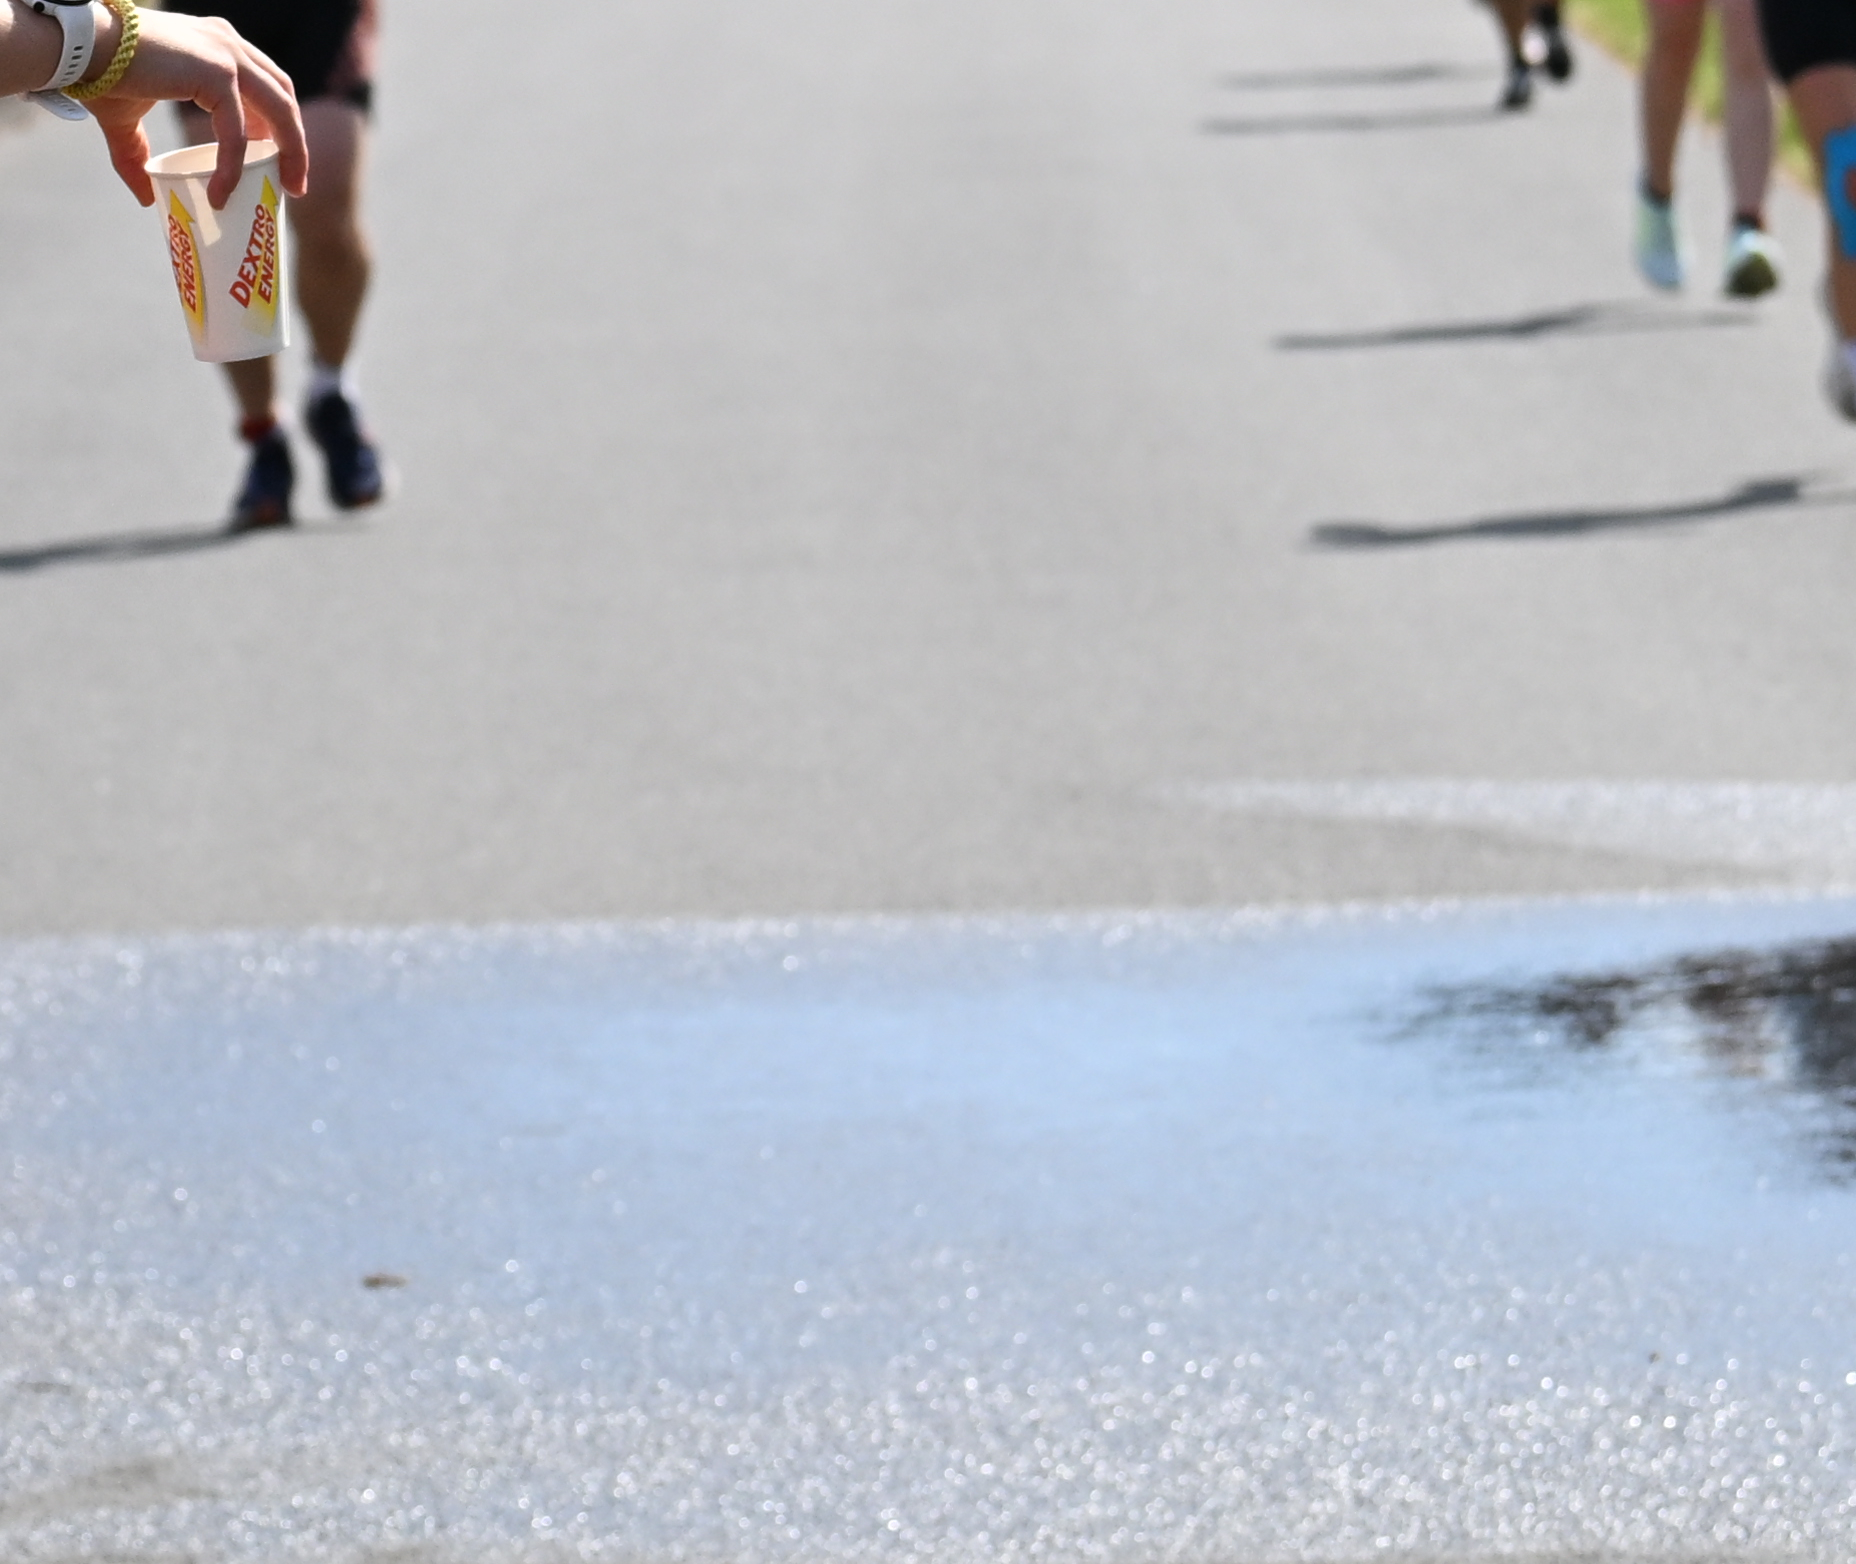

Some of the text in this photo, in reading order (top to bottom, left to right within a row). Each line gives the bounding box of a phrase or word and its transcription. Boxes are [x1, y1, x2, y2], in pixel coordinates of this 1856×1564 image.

[177, 219, 197, 314] ENERGY
[228, 204, 265, 309] DEXTRO
[257, 206, 275, 305] ENERGY
